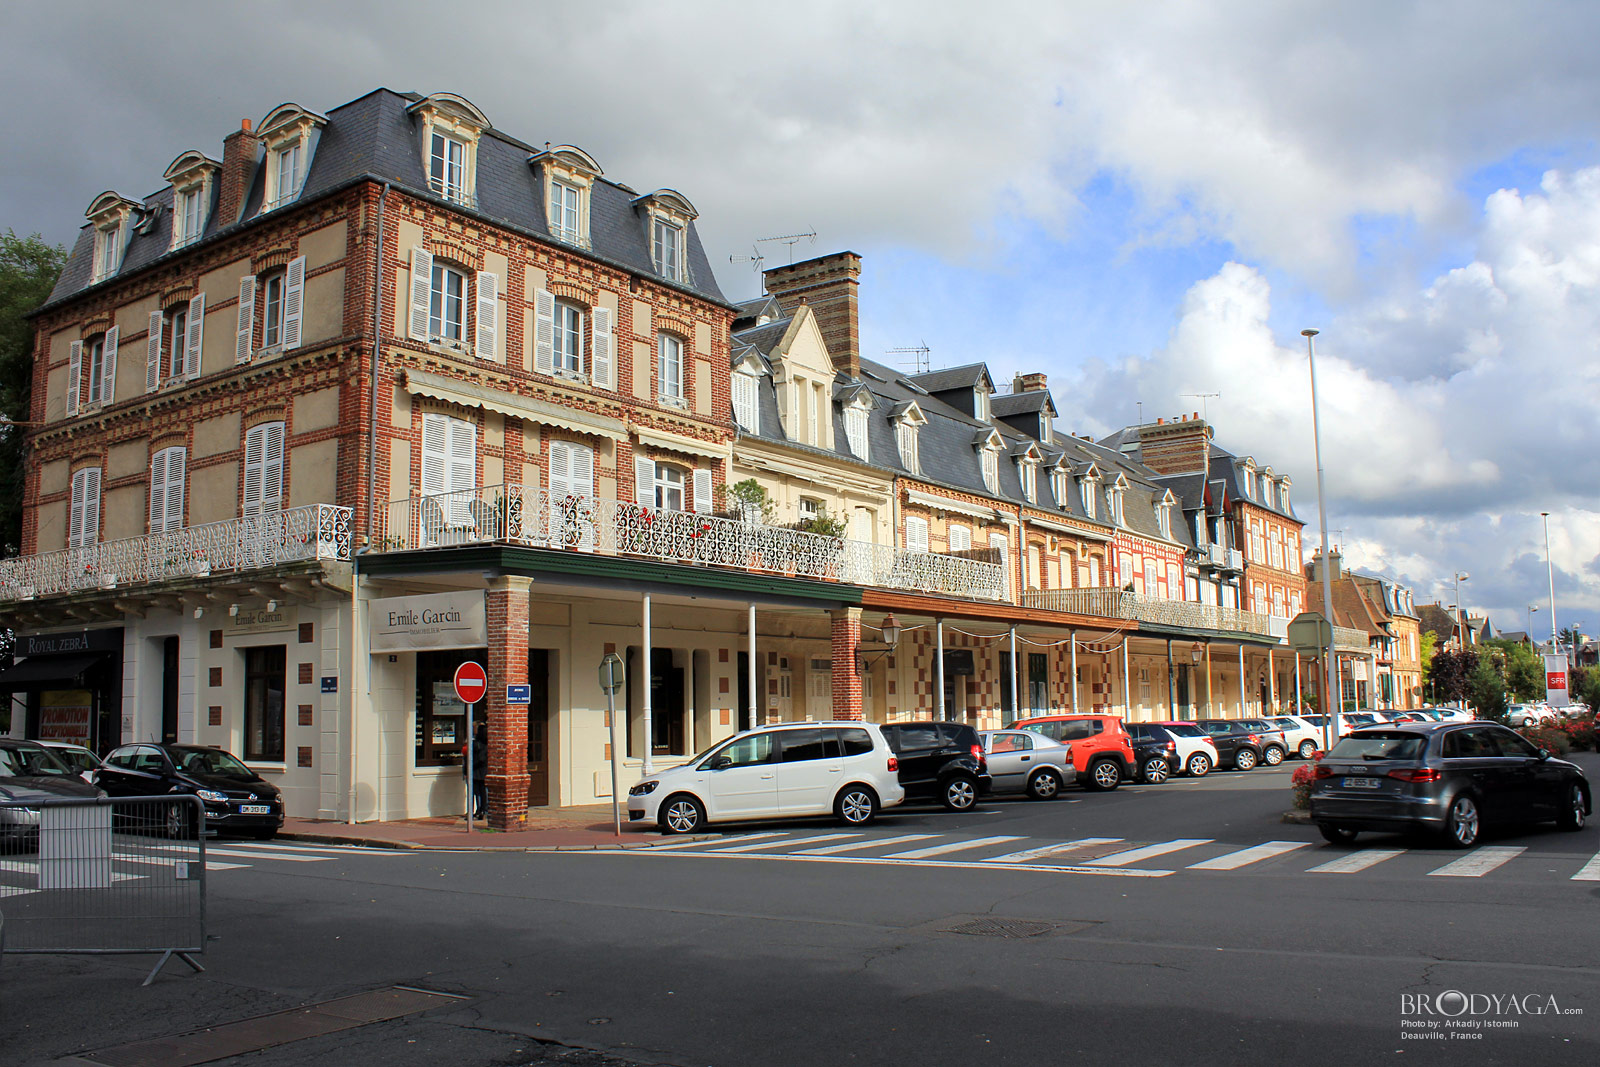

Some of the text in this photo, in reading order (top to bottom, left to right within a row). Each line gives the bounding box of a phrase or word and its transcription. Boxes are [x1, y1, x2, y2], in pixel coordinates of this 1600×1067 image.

[235, 611, 282, 626] Emile Garcin
[388, 606, 461, 627] Emile Garcin
[28, 637, 56, 654] ROYAL
[1550, 677, 1565, 685] SFR
[41, 707, 89, 724] PROMOTION
[40, 725, 88, 738] EXCEPTIONNELLE
